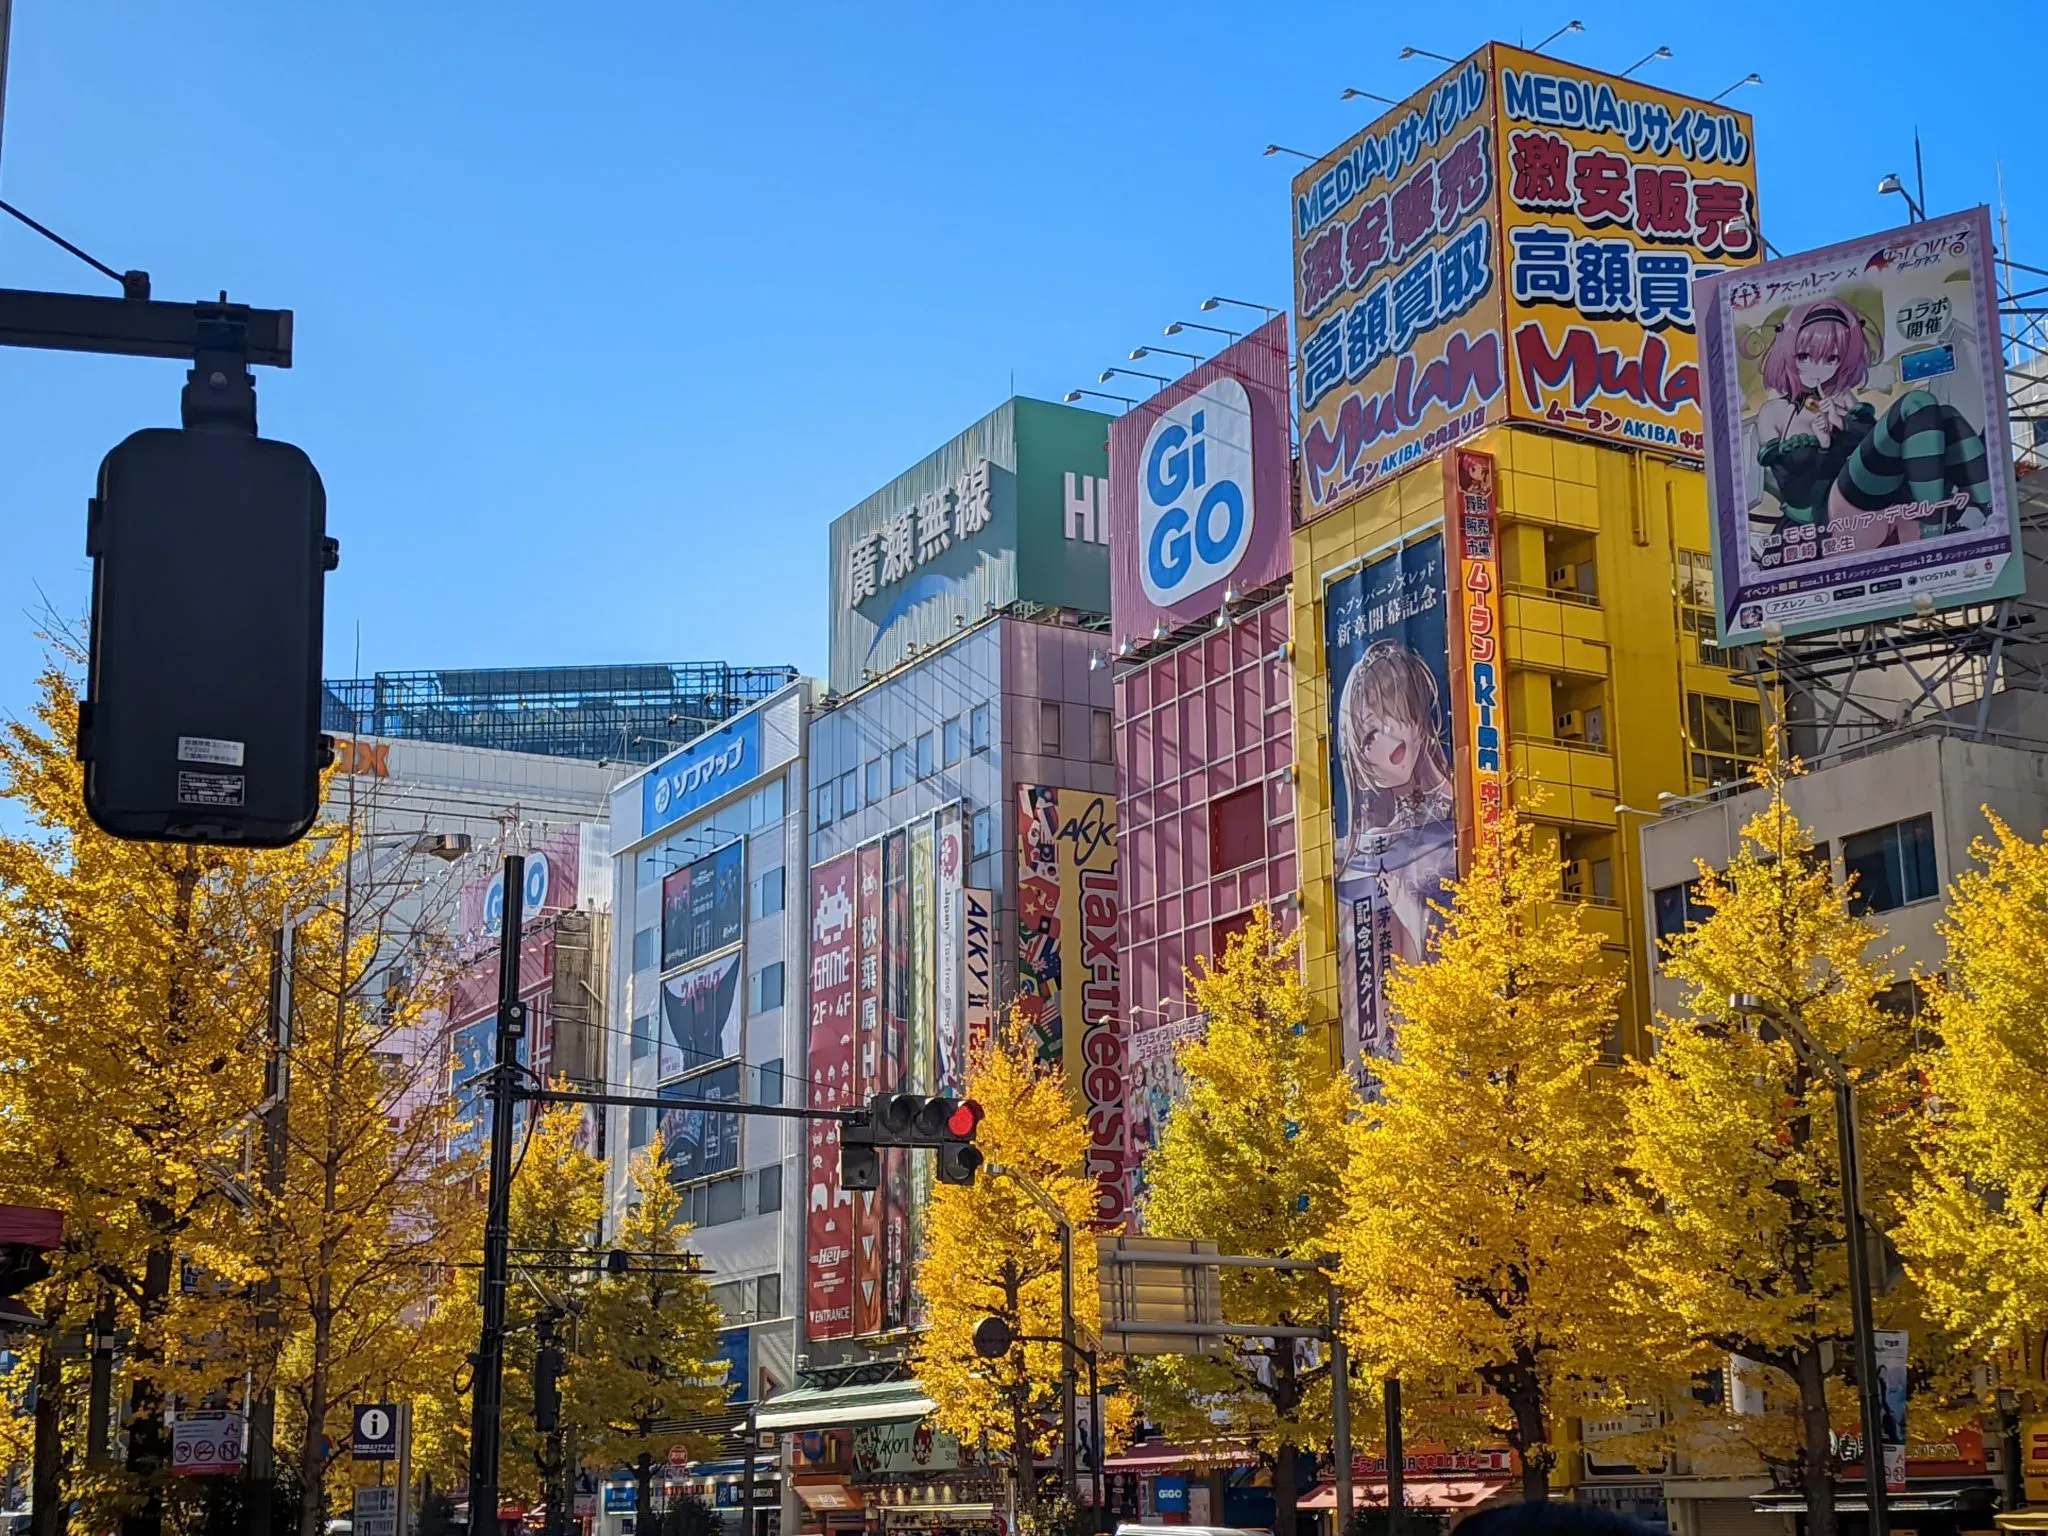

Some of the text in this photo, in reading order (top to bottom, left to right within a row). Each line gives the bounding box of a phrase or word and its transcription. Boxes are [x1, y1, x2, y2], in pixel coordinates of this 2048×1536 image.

[1503, 67, 1749, 165] MEDIAリサイクル
[1299, 60, 1487, 240] MEDIAリサイクル
[1301, 128, 1490, 314] 激安販売
[1510, 129, 1750, 253] 激安販売
[1510, 225, 1738, 330] 高額買
[1897, 296, 1949, 323] コラボ
[1302, 218, 1490, 410] 高額買取
[1906, 317, 1943, 339] 開催
[1304, 330, 1502, 504] Mulan
[1762, 552, 1781, 567] CV
[1919, 569, 1957, 583] YOSTAR
[1336, 584, 1437, 649] 新章開幕記念
[1772, 599, 1806, 612] アズレン
[673, 736, 745, 800] ソフマップ
[1375, 835, 1389, 899] 主人公
[814, 945, 851, 993] GAME
[967, 893, 990, 991] AKKY
[818, 1246, 841, 1268] Hey
[815, 1306, 851, 1324] ENTRANCE
